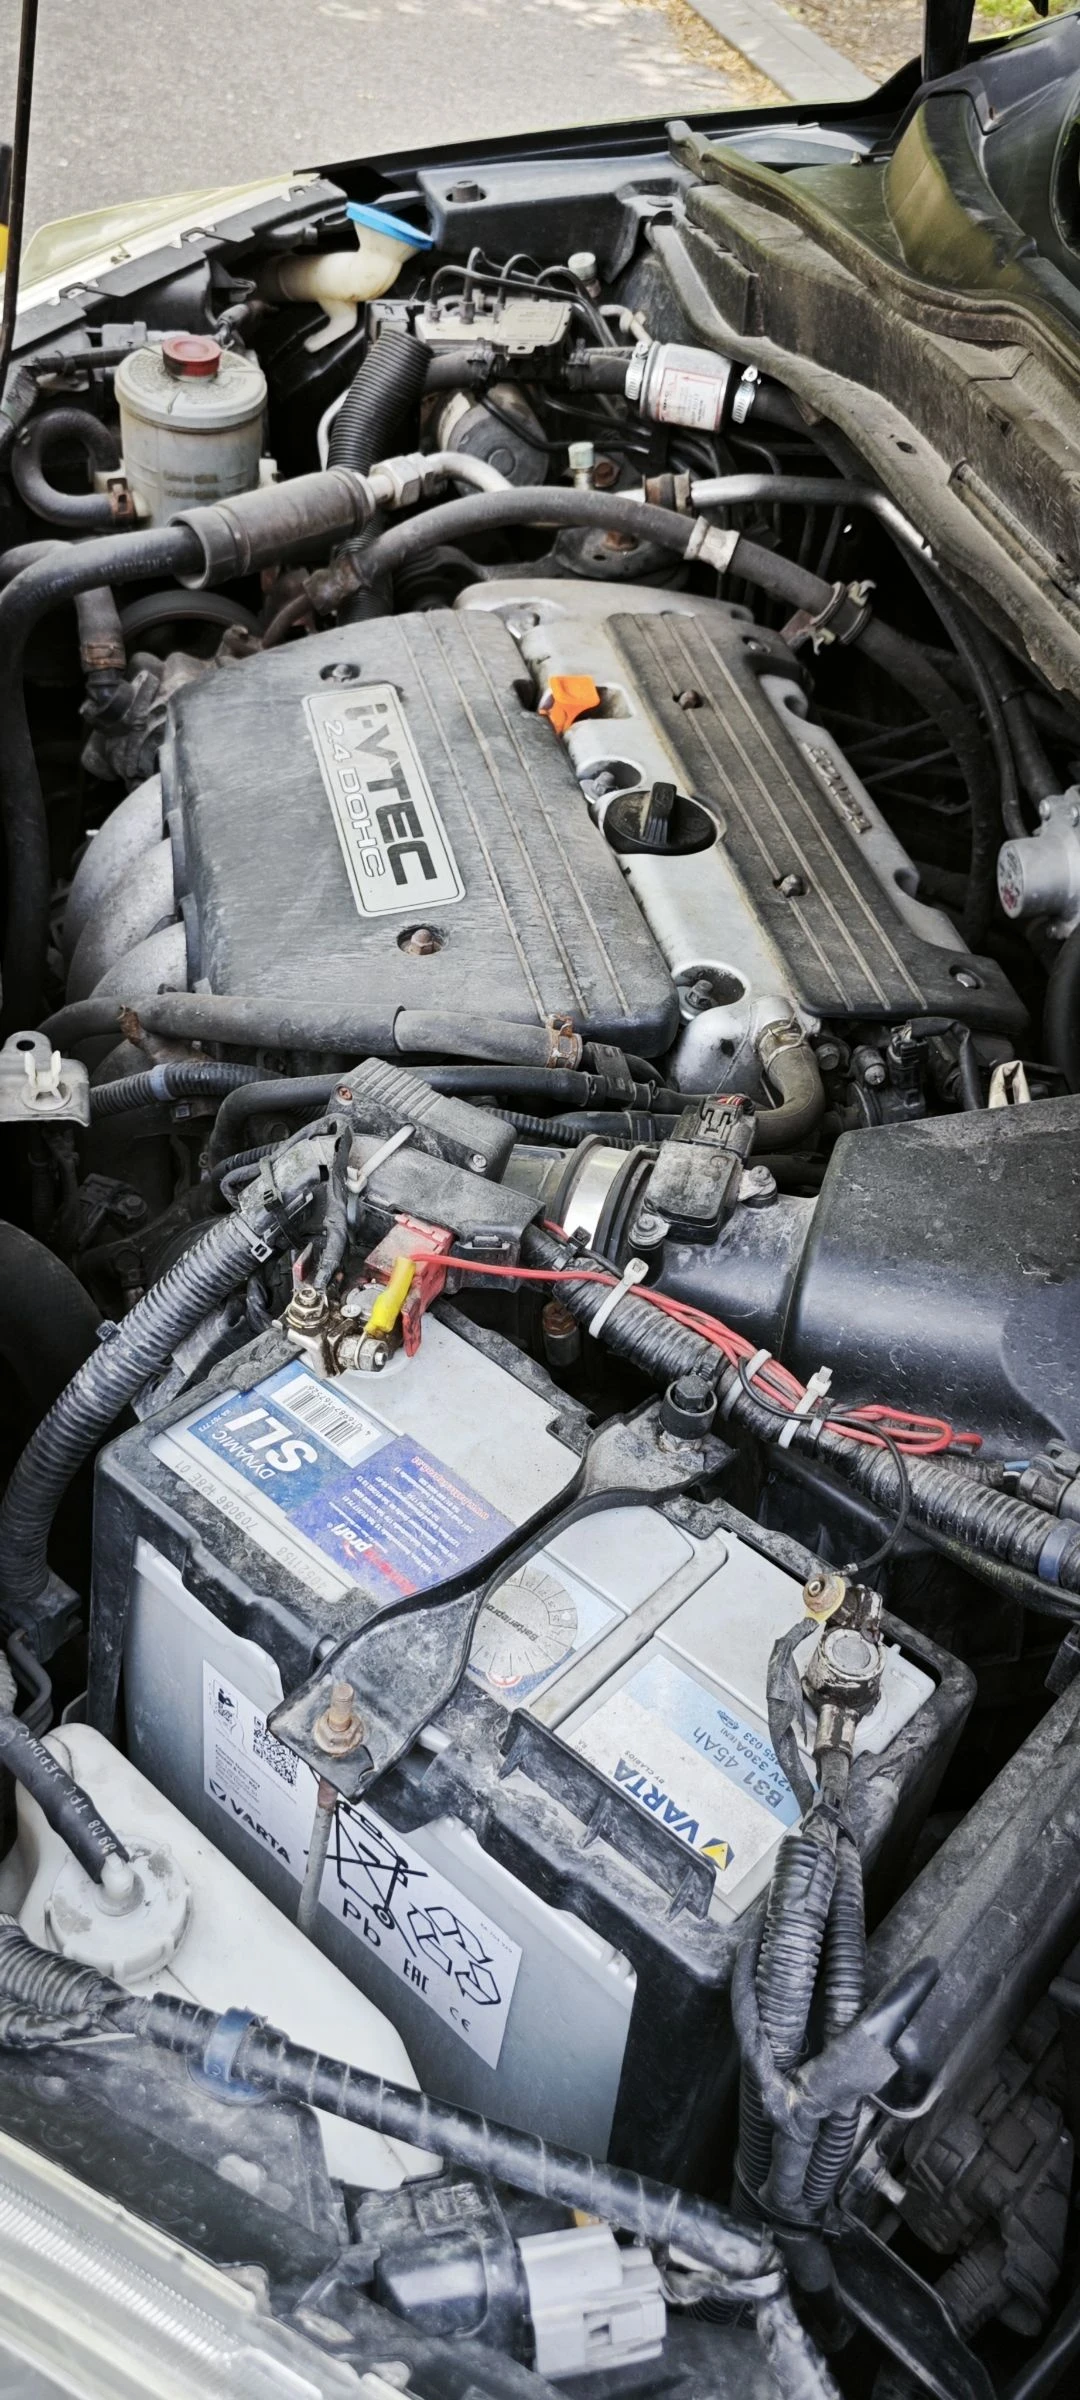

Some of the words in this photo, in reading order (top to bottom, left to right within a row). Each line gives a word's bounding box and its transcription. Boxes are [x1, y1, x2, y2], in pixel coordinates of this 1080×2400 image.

[323, 719, 352, 763] 2.4
[337, 767, 386, 878] DOHC
[212, 1430, 275, 1480] DYNAMIC
[226, 1407, 319, 1473] SLI
[624, 1749, 655, 1776] CLARIOS
[690, 1726, 741, 1772] 45Ah
[742, 1731, 764, 1749] 033
[609, 1757, 702, 1844] VARTA
[741, 1769, 785, 1808] B31
[230, 1797, 292, 1864] VARTA
[342, 1898, 383, 1947] Pb
[403, 1957, 430, 1994] EAC
